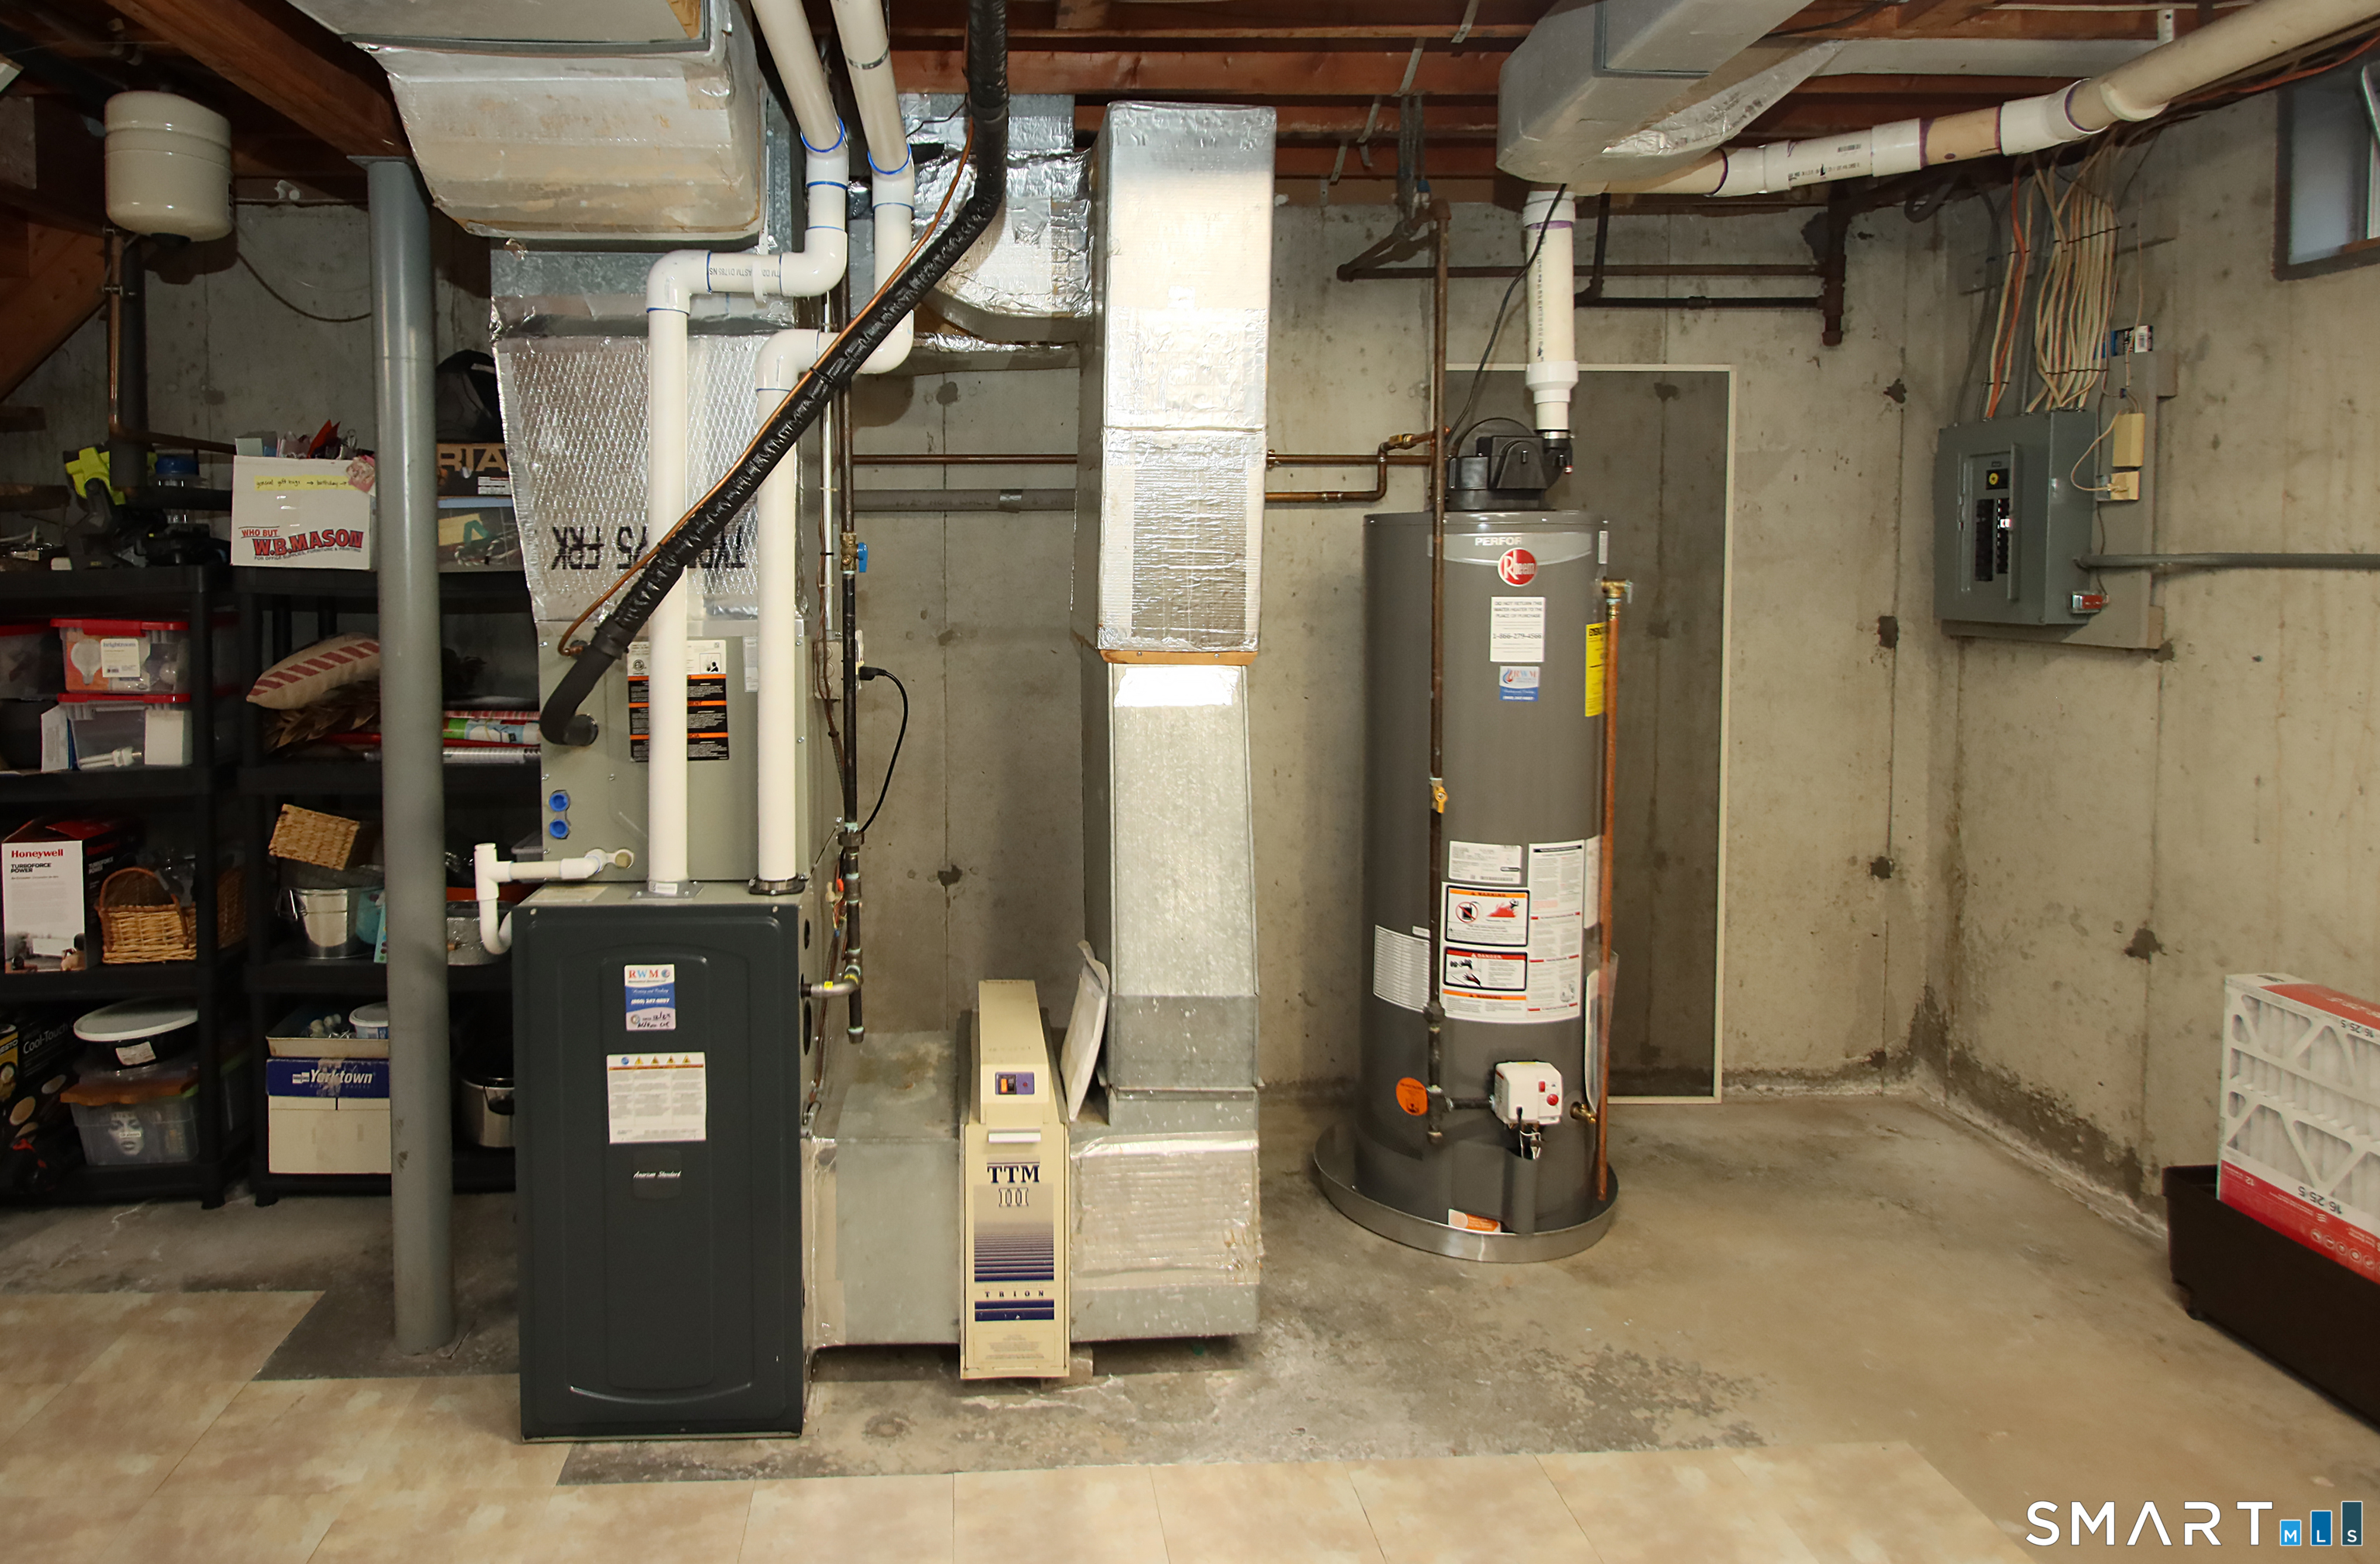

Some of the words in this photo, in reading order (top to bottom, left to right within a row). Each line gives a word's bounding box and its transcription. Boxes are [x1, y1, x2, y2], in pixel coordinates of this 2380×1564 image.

[316, 479, 339, 488] birthday
[551, 527, 604, 570] FRK
[1503, 549, 1535, 580] Rheem
[11, 849, 64, 859] Honeywell
[628, 969, 659, 979] RWM
[23, 1023, 69, 1054] Cool-Touch
[311, 1069, 373, 1084] Yorktown
[987, 1165, 1040, 1184] TTM
[2298, 1186, 2306, 1197] 5
[2309, 1192, 2325, 1206] 25
[2329, 1201, 2343, 1215] 16
